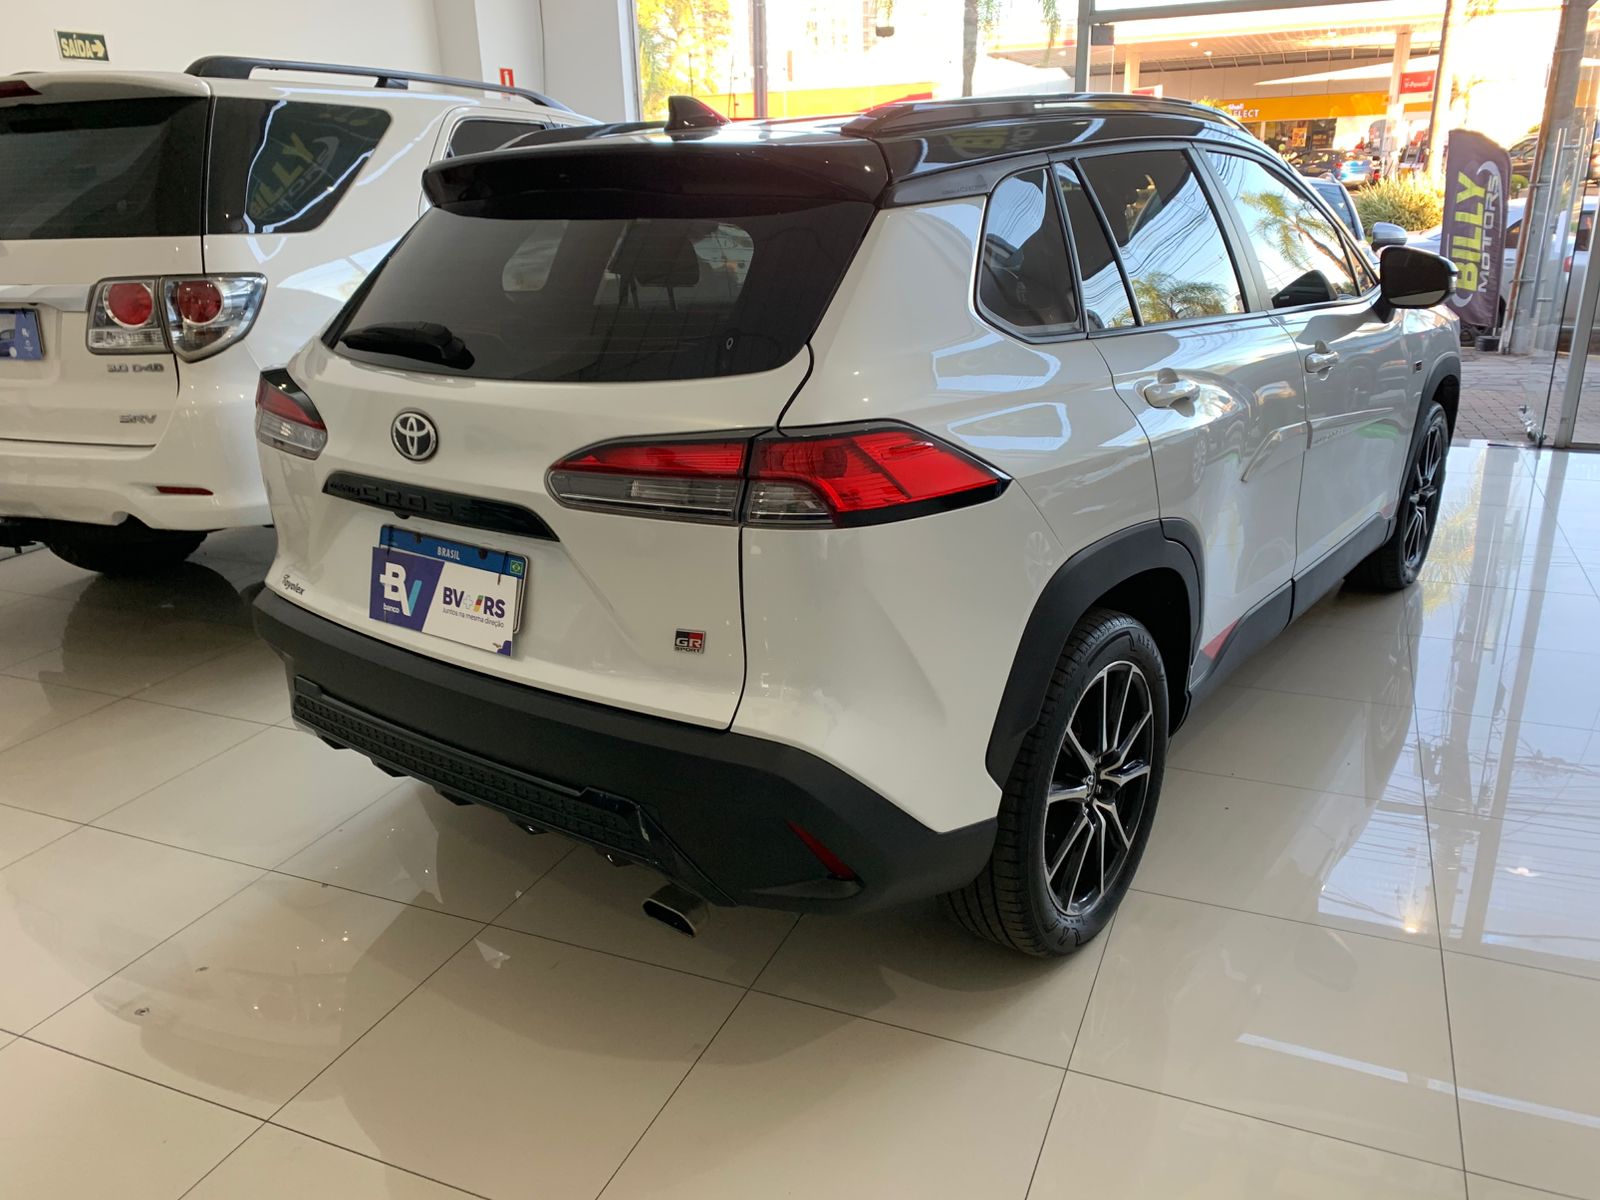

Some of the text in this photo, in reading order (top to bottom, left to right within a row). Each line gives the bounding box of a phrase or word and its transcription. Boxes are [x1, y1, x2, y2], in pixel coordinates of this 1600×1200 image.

[61, 33, 95, 58] SAÍDA
[1452, 170, 1486, 292] BILLY
[1477, 174, 1500, 293] MOTORS
[119, 414, 158, 425] SRV
[437, 546, 461, 560] BRASIL
[380, 562, 423, 617] BV
[675, 637, 702, 647] GR
